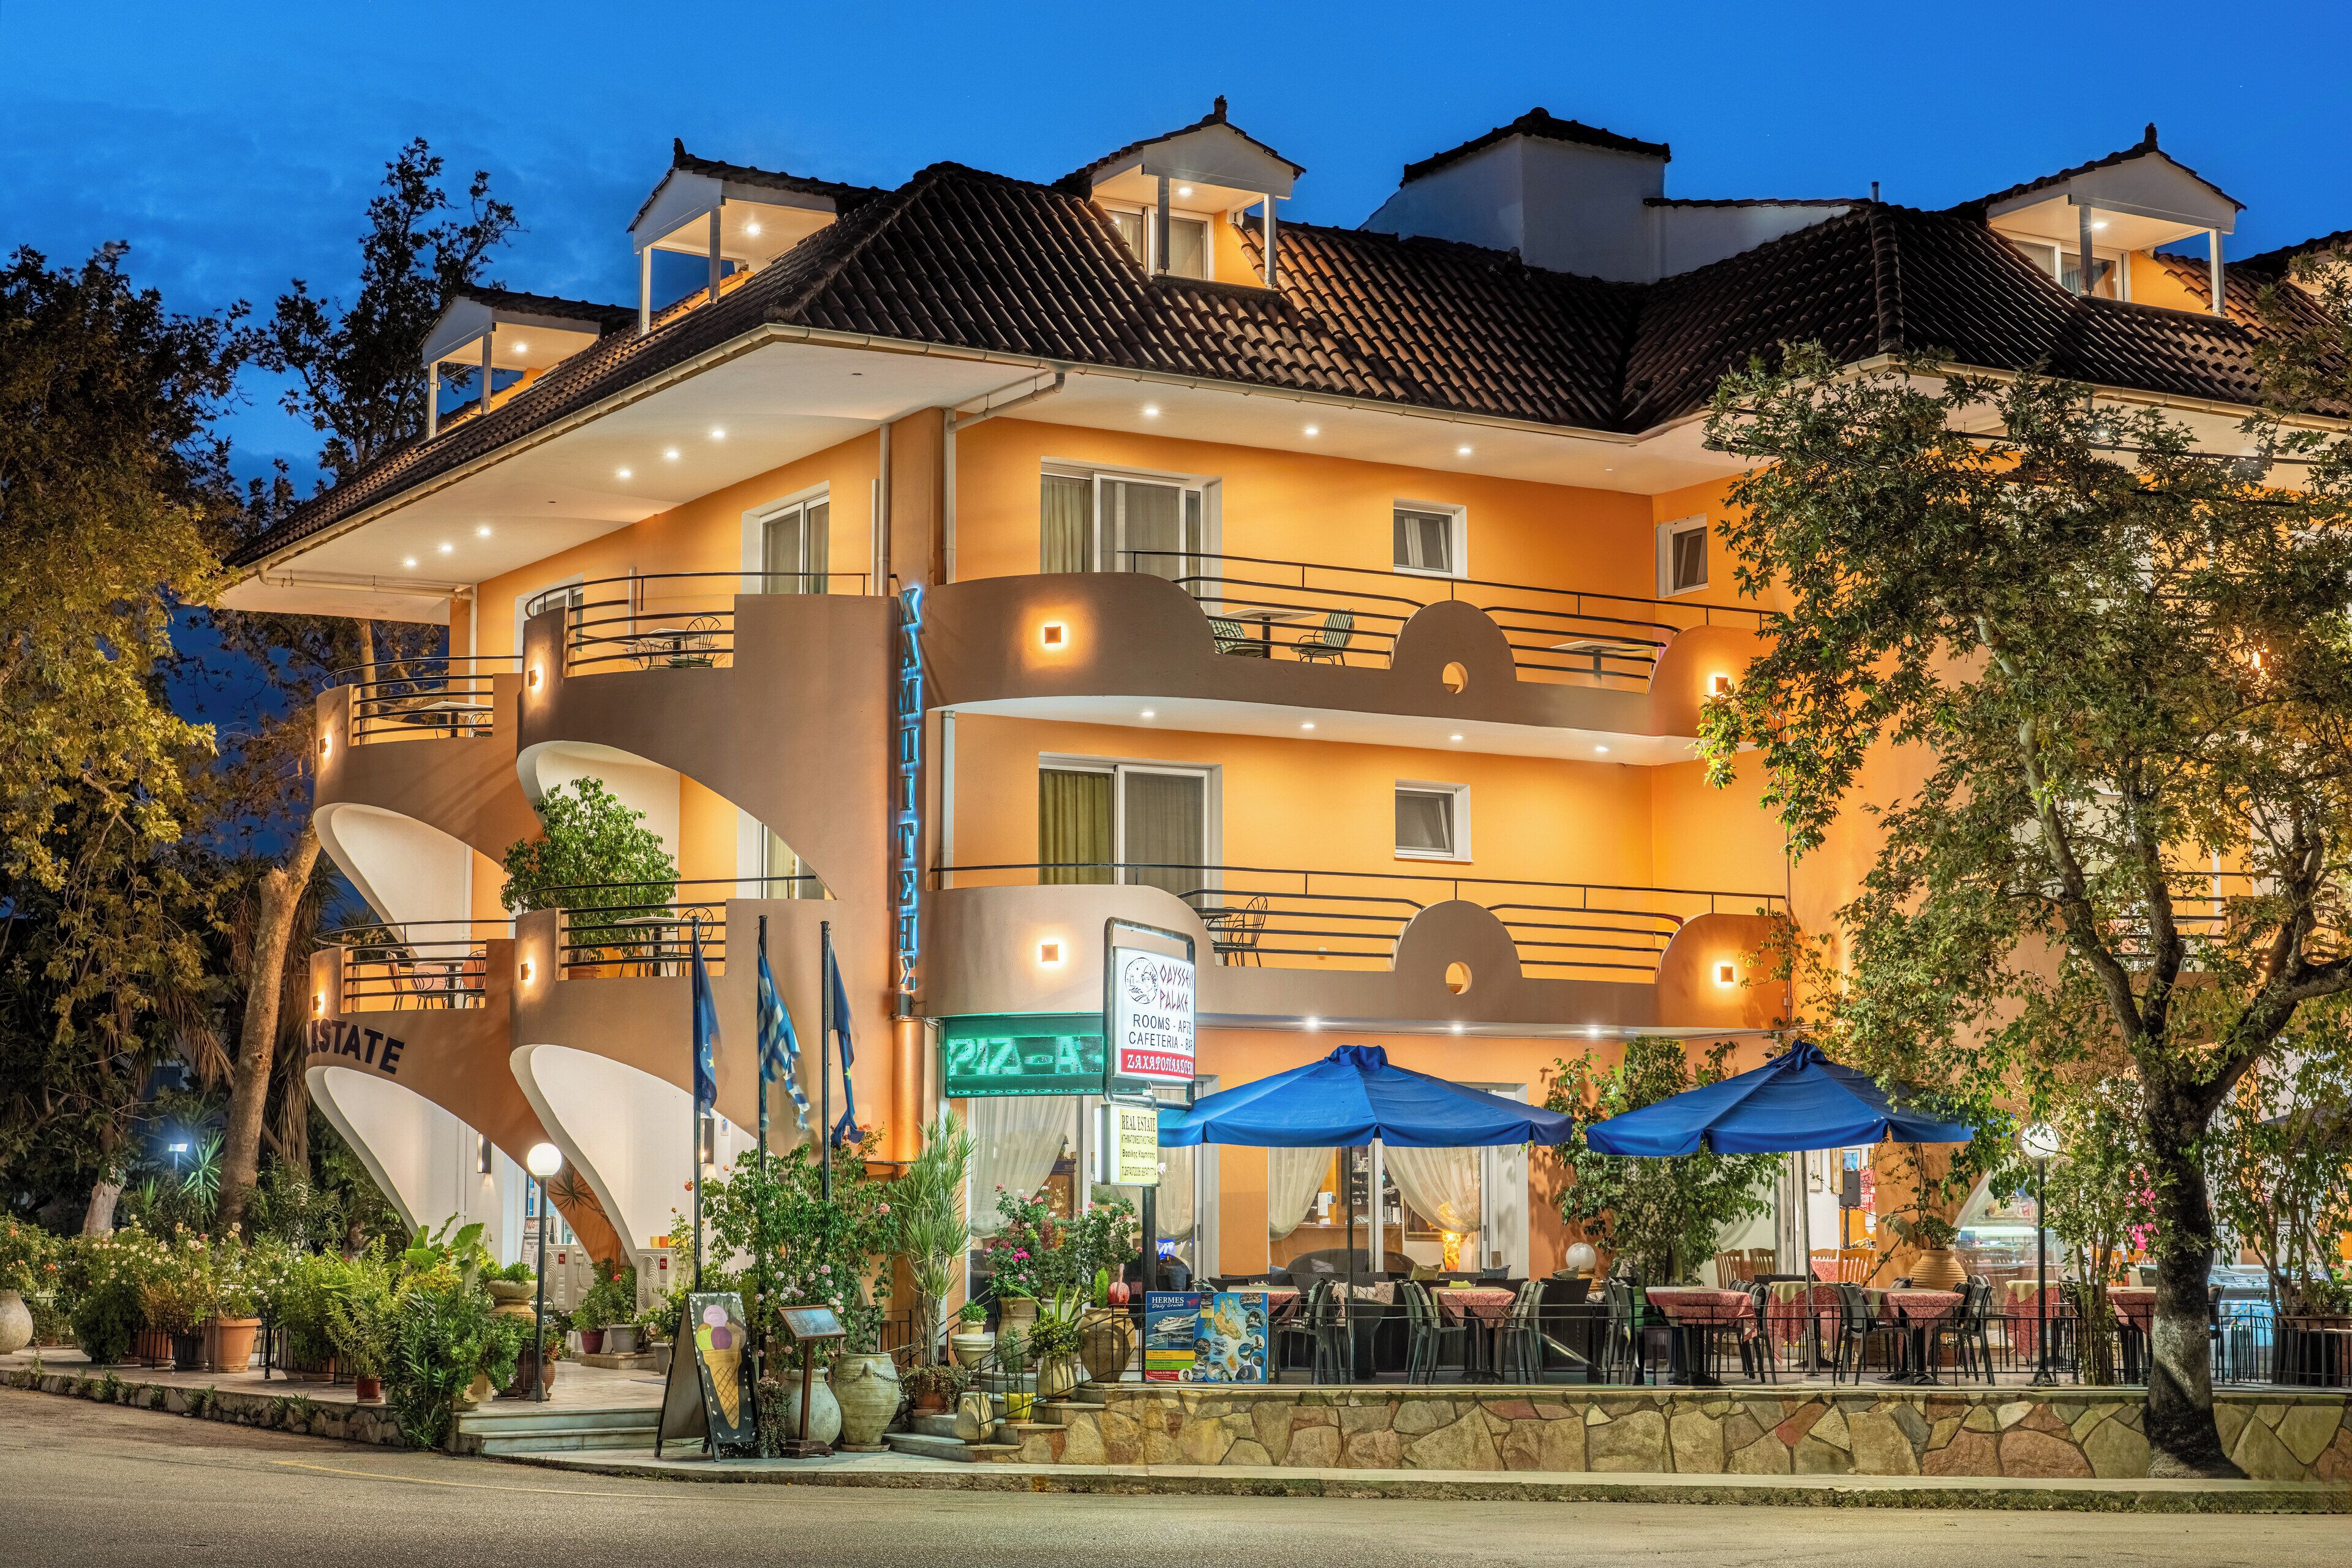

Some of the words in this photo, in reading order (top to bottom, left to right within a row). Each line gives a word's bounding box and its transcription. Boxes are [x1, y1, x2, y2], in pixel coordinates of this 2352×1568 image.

[1159, 989, 1188, 1012] PALACE
[1133, 1014, 1170, 1030] ROOMS
[311, 1018, 405, 1075] ESTATE
[1129, 1031, 1178, 1049] CAFETERIA
[1121, 1115, 1136, 1130] REAL
[1137, 1117, 1156, 1132] ESTATE
